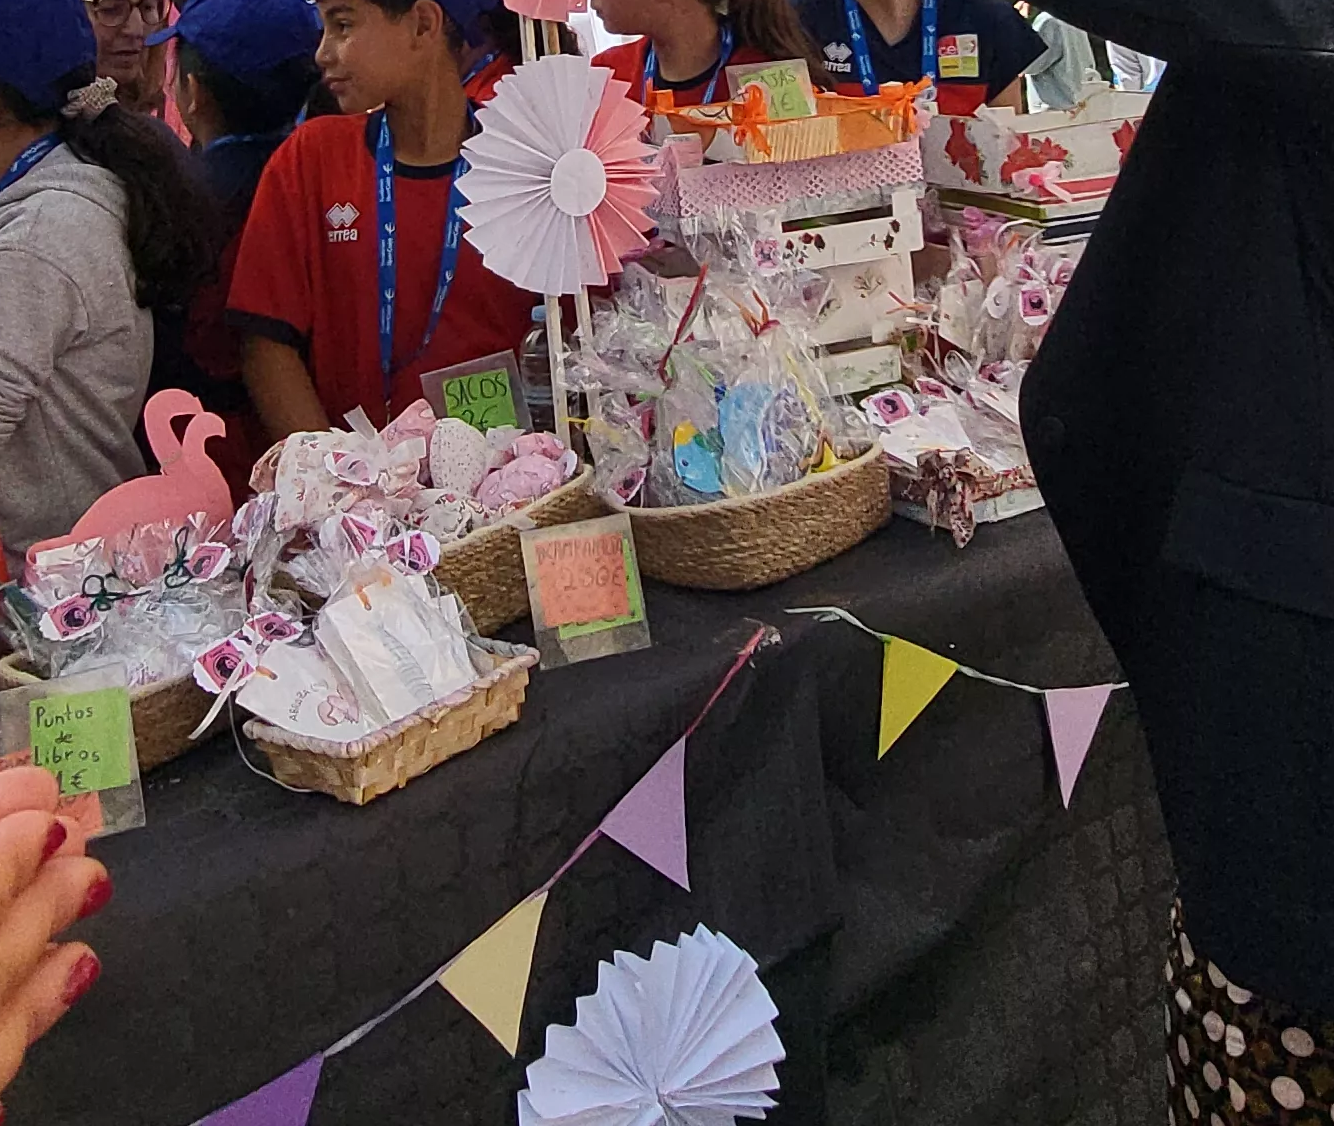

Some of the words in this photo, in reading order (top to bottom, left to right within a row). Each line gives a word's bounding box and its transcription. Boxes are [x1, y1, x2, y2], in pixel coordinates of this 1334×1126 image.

[445, 371, 507, 410] SACOS
[36, 703, 94, 728] Puntos
[55, 731, 73, 744] de
[34, 746, 100, 767] Libros
